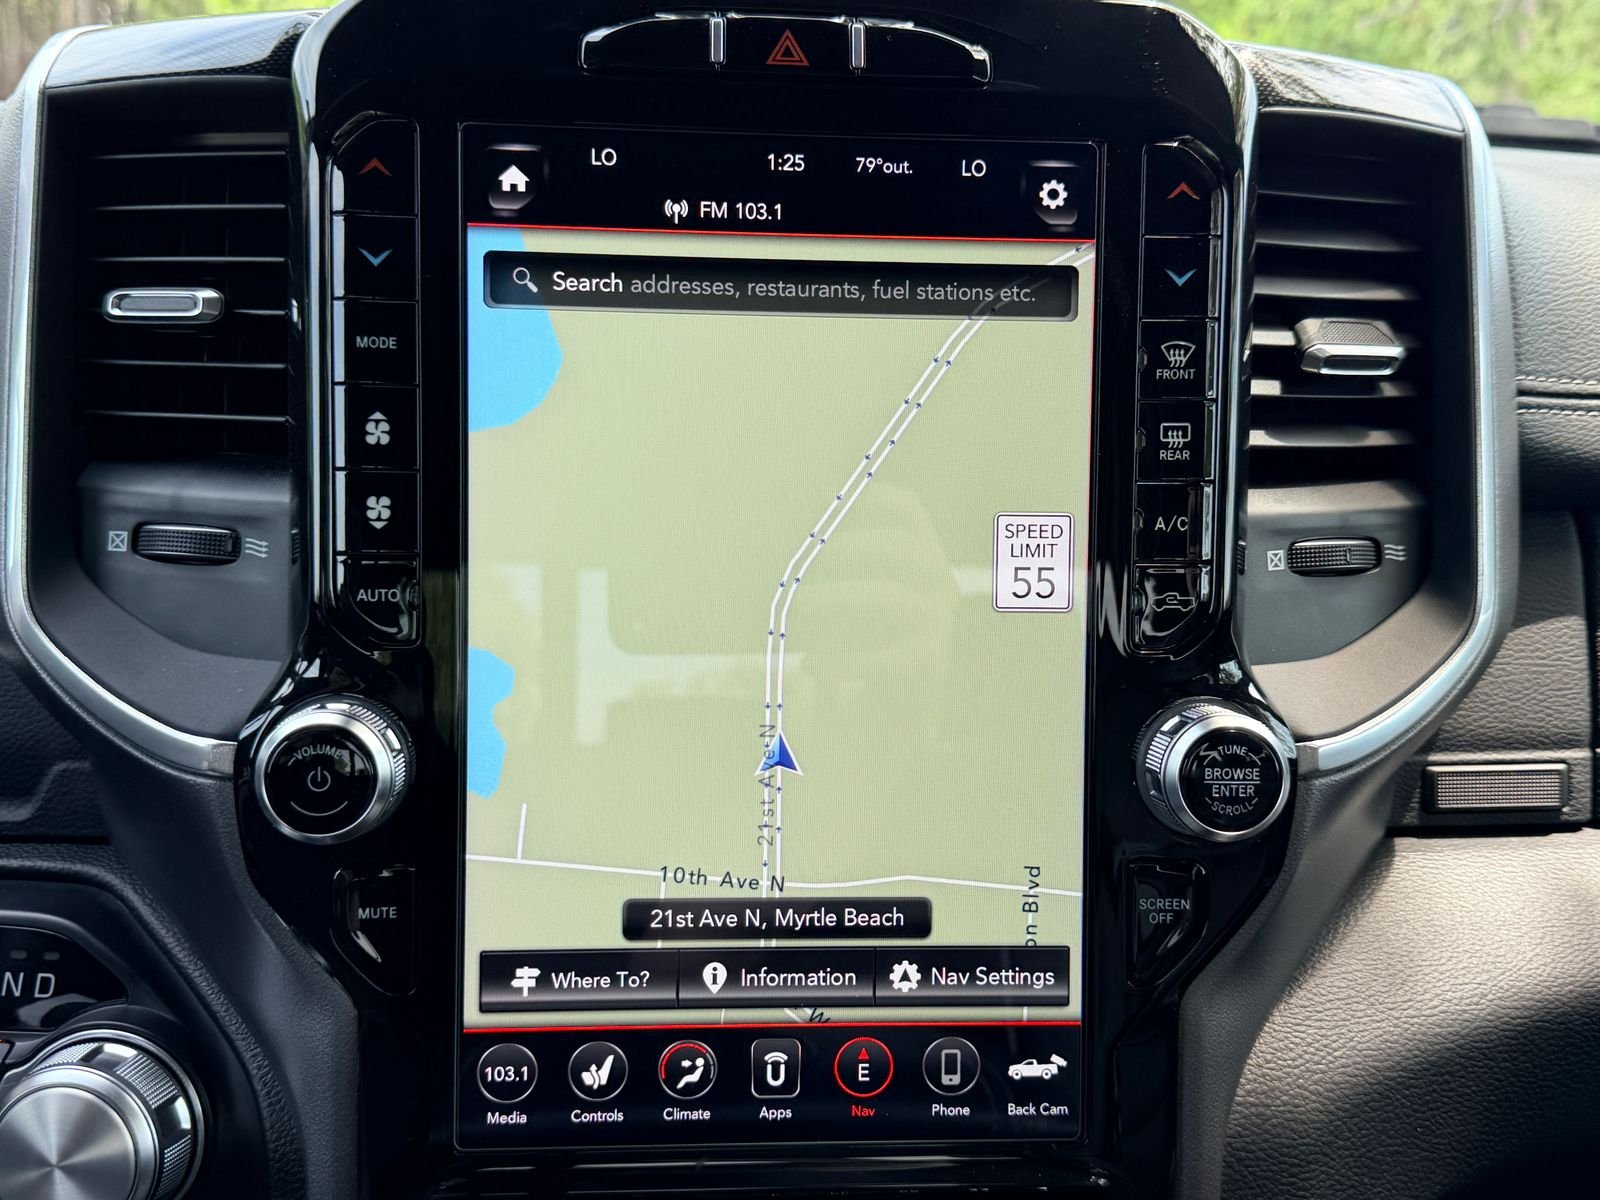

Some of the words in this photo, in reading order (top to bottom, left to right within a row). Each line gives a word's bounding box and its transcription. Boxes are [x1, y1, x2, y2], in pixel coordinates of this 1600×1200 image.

[591, 147, 617, 166] LO
[767, 153, 805, 172] 1:25
[961, 159, 987, 177] LO
[700, 201, 728, 219] FM
[735, 202, 781, 220] 103.1
[552, 270, 623, 293] Search
[630, 273, 740, 299] addresses,
[747, 280, 866, 302] restaurants,
[871, 278, 909, 300] fuel
[916, 282, 994, 302] stations
[1000, 285, 1036, 302] etc.
[356, 335, 397, 349] MODE
[1156, 365, 1196, 380] FRONT
[1159, 449, 1190, 461] REAR
[1004, 523, 1064, 540] SPEED
[1153, 514, 1189, 533] A/C
[1010, 543, 1059, 559] LIMIT
[1011, 566, 1056, 600] 55
[355, 588, 401, 603] AUTO
[758, 724, 776, 739] N
[294, 744, 342, 760] VOLUME
[1217, 745, 1248, 757] TUNE
[758, 749, 775, 788] Ave
[1203, 767, 1261, 781] BROWSE
[1211, 784, 1256, 798] ENTER
[1211, 801, 1252, 815] SCROLL
[757, 799, 775, 846] 21st
[659, 865, 708, 887] 10th
[719, 871, 761, 891] Ave
[769, 875, 786, 893] N
[1021, 865, 1042, 913] Blvd
[1138, 897, 1191, 911] SCREEN
[358, 906, 397, 920] MUTE
[650, 909, 694, 928] 21st
[698, 908, 738, 928] Ave
[745, 908, 767, 930] N,
[775, 906, 837, 931] Myrtle
[844, 906, 904, 926] Beach
[1148, 912, 1175, 925] OFF
[1, 972, 24, 997] N
[34, 973, 56, 998] D
[551, 970, 611, 989] Where
[616, 970, 650, 988] To?
[740, 967, 857, 988] Information
[931, 966, 970, 986] Nav
[975, 966, 1055, 989] Settings
[485, 1065, 528, 1082] 103.1
[858, 1063, 870, 1082] E
[487, 1110, 527, 1124] Media
[570, 1108, 624, 1123] Controls
[663, 1107, 711, 1121] Climate
[758, 1105, 793, 1122] Apps
[851, 1104, 875, 1117] Nav
[932, 1103, 971, 1116] Phone
[1007, 1102, 1037, 1116] Back
[1039, 1102, 1069, 1116] Cam
